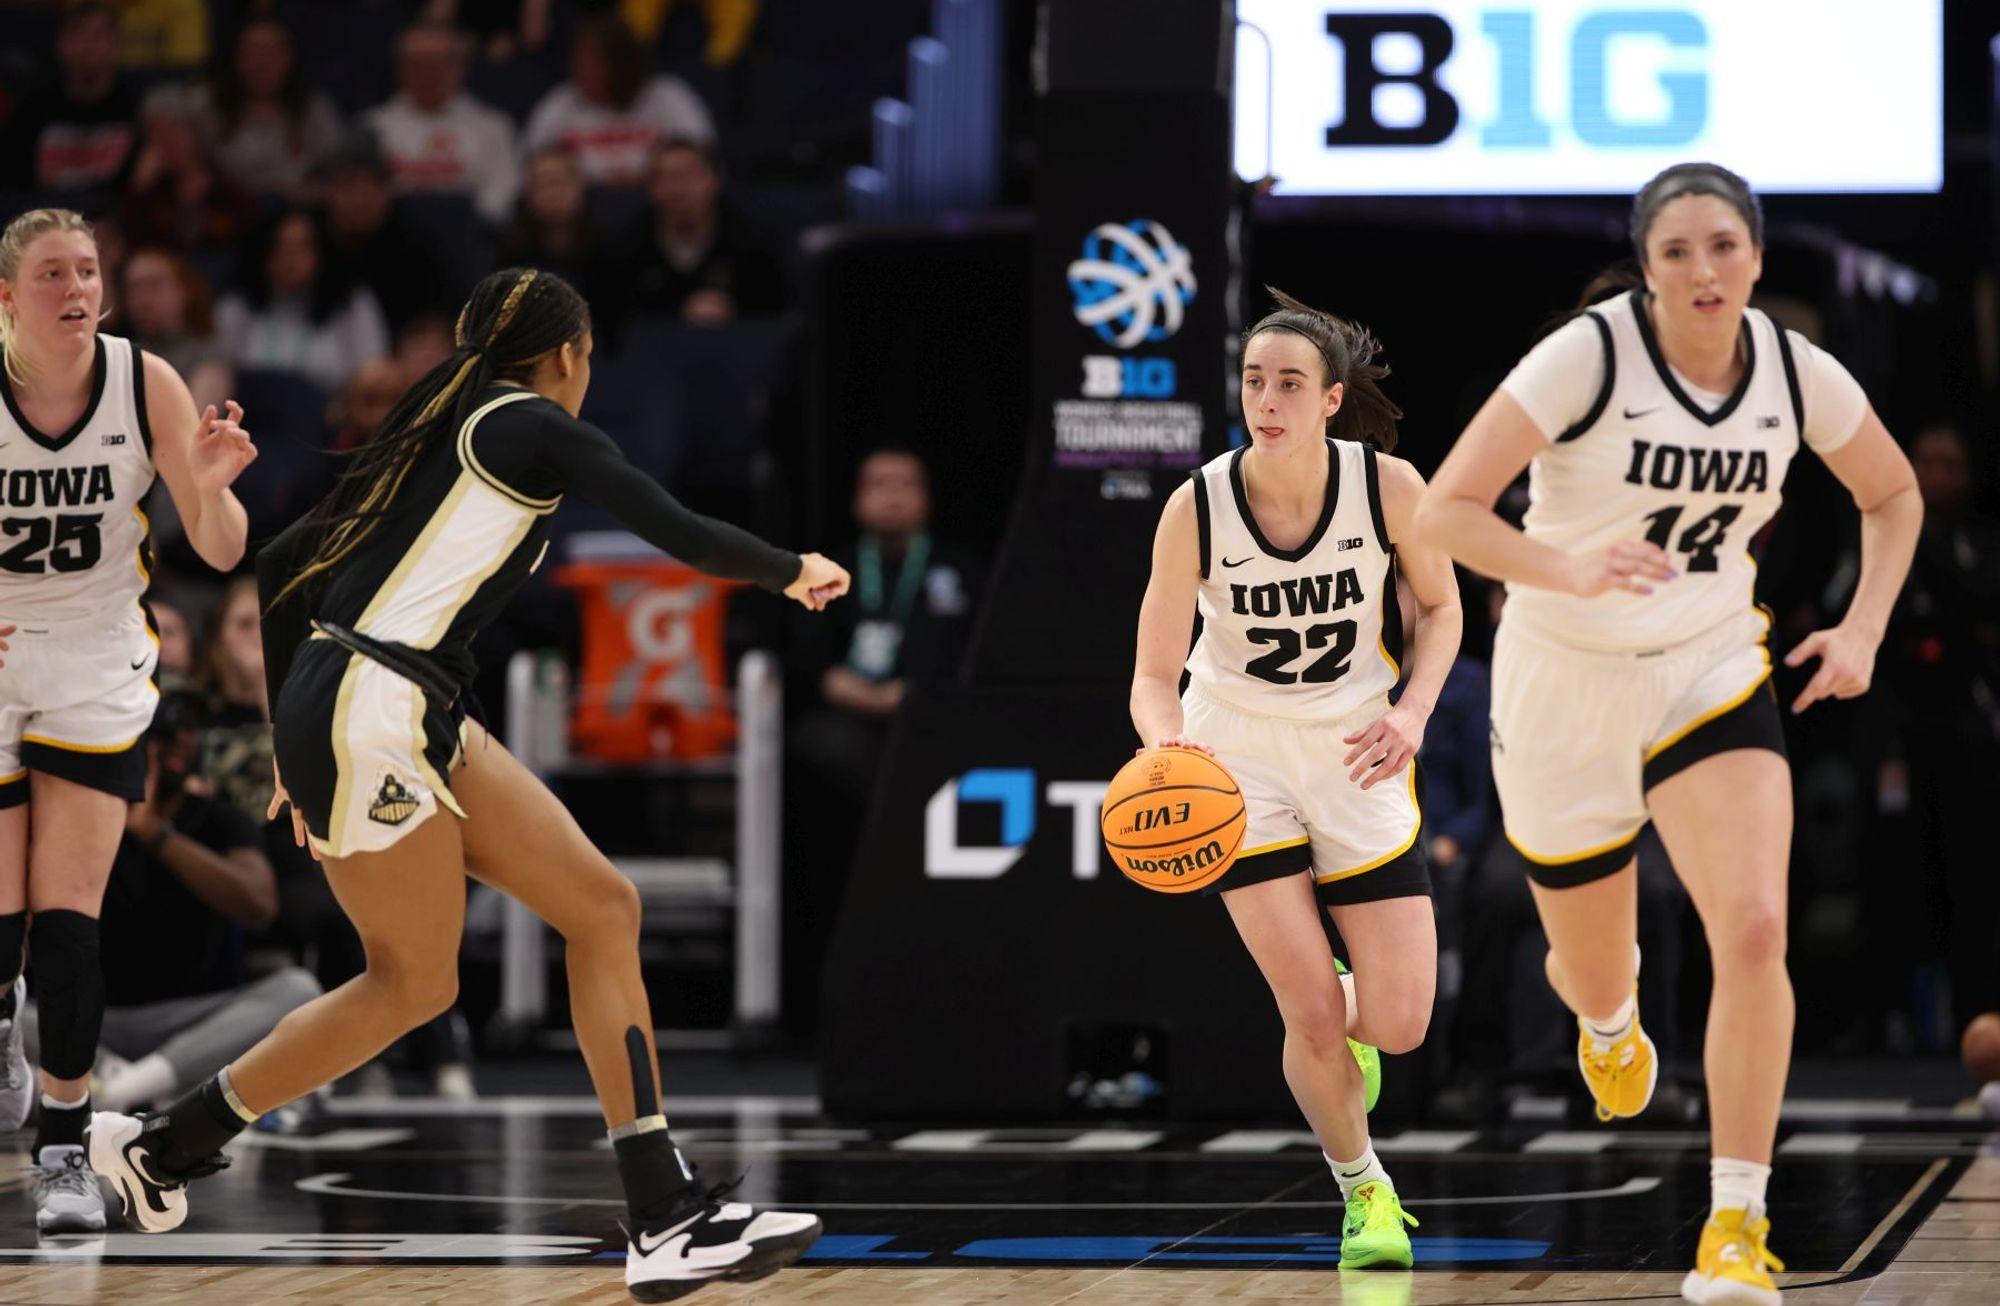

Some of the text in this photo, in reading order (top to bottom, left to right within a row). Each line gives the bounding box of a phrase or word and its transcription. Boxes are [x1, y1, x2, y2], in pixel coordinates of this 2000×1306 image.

[1625, 438, 1768, 493] IOWA
[0, 512, 104, 574] 25
[1642, 504, 1743, 572] 14
[1230, 567, 1365, 618] IOWA
[1245, 619, 1357, 684] 22
[924, 767, 1108, 879] OT
[1134, 802, 1190, 832] EVO
[1126, 840, 1225, 877] Wilson
